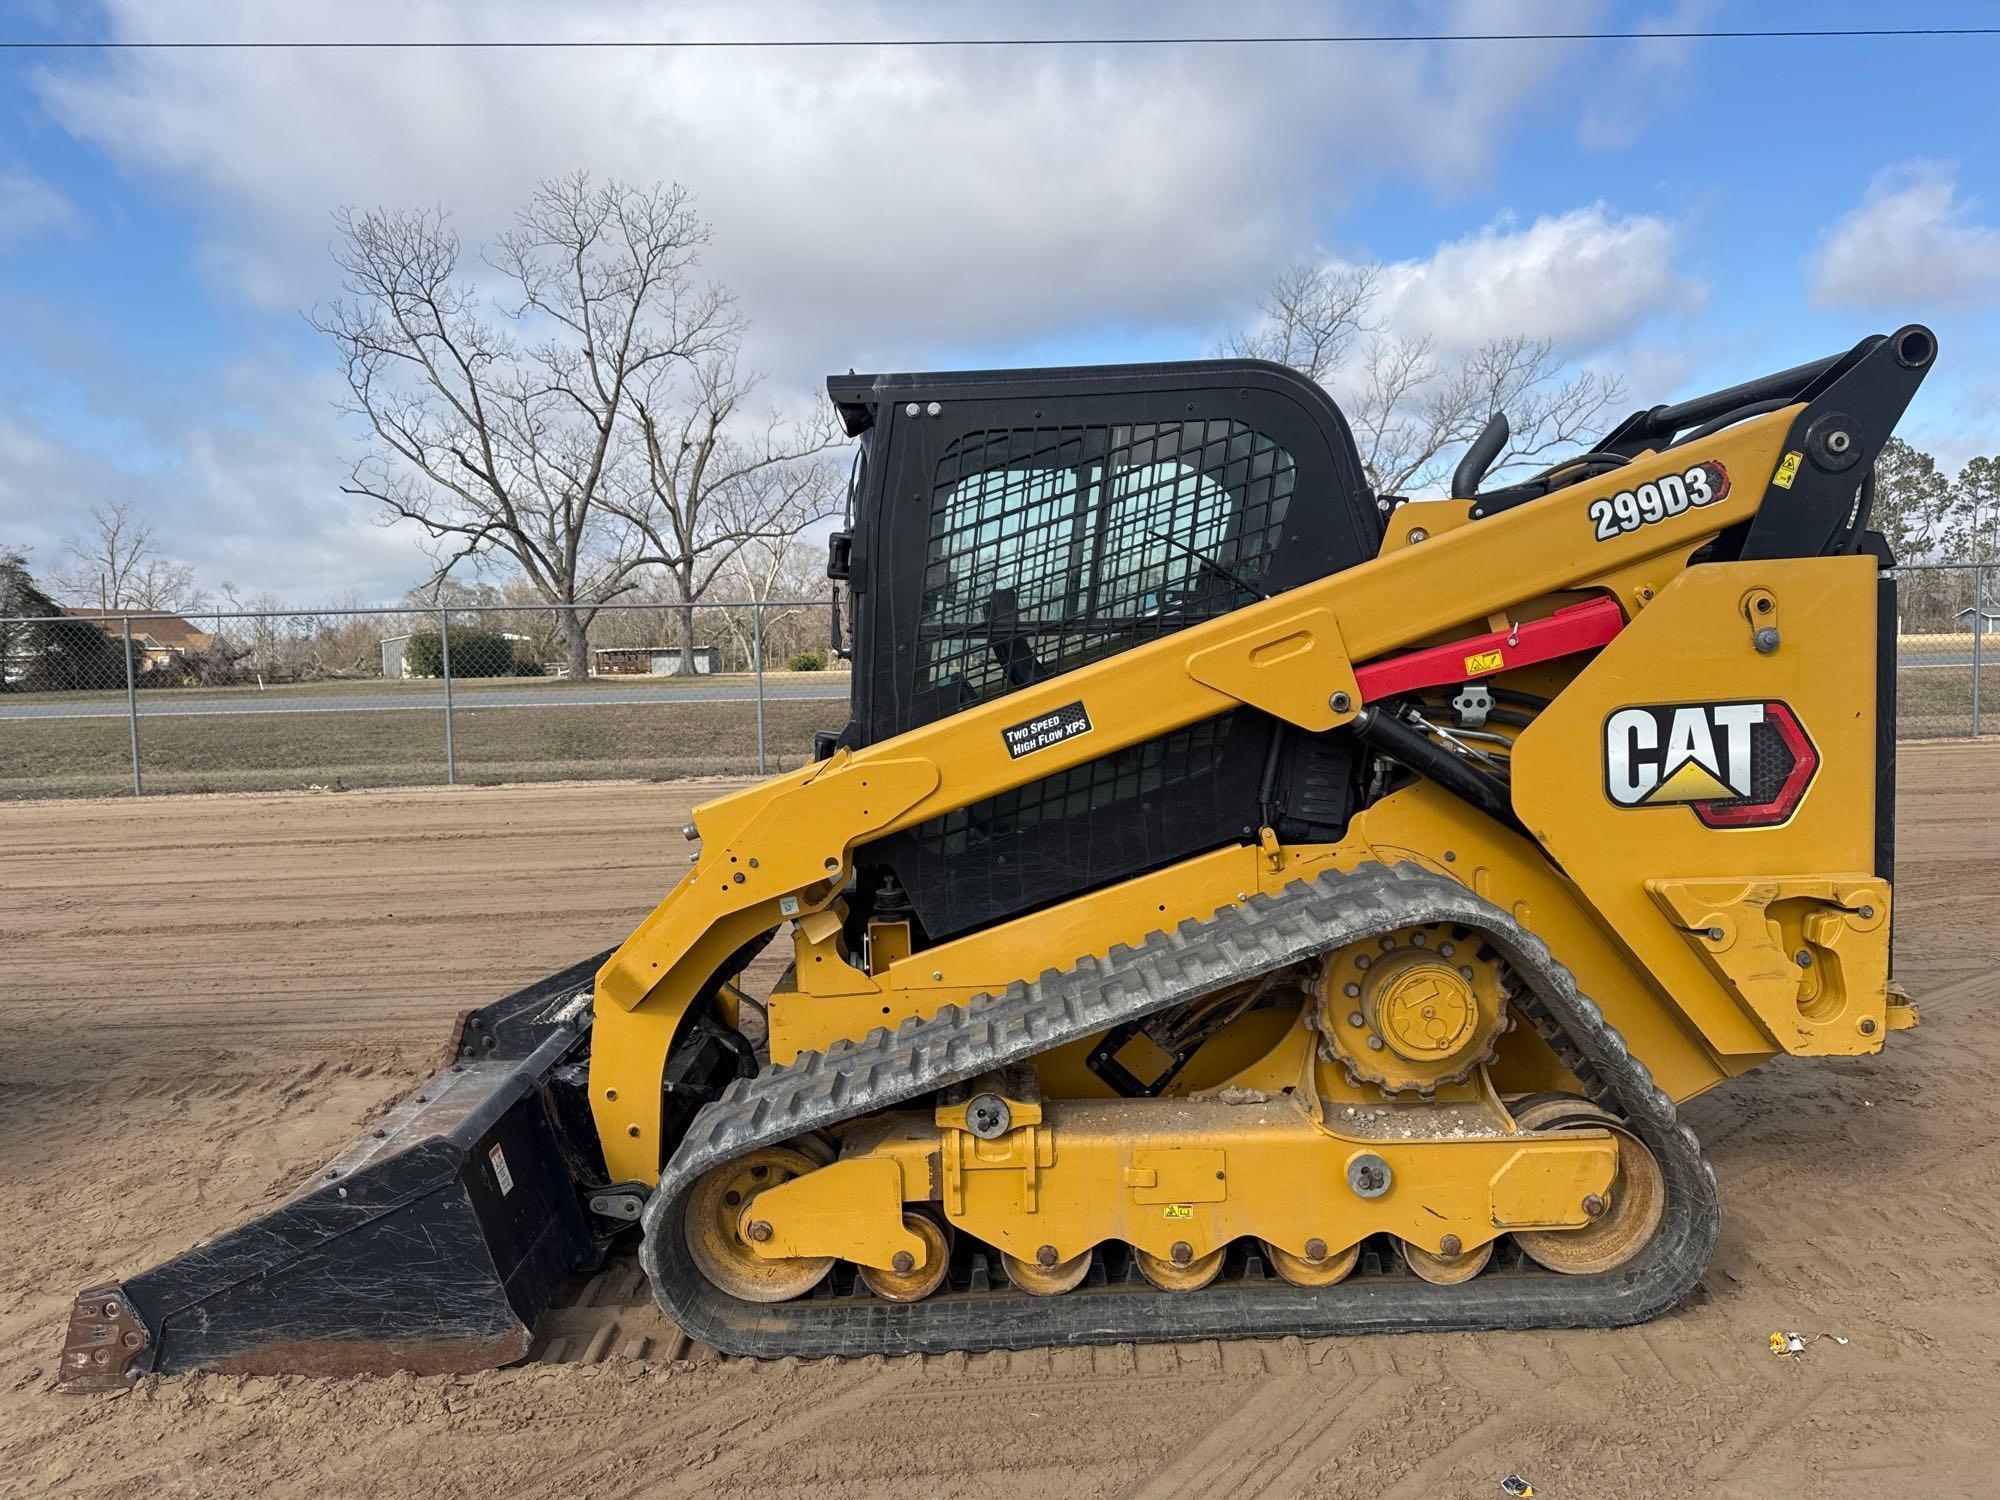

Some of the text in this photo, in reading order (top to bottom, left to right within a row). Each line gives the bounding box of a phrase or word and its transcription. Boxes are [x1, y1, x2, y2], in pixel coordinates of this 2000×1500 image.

[1590, 467, 1712, 540] 299D3
[1006, 715, 1060, 743] TWO SPEED
[1013, 718, 1086, 756] HIGH FLOW XPS
[1607, 704, 1764, 804] CAT
